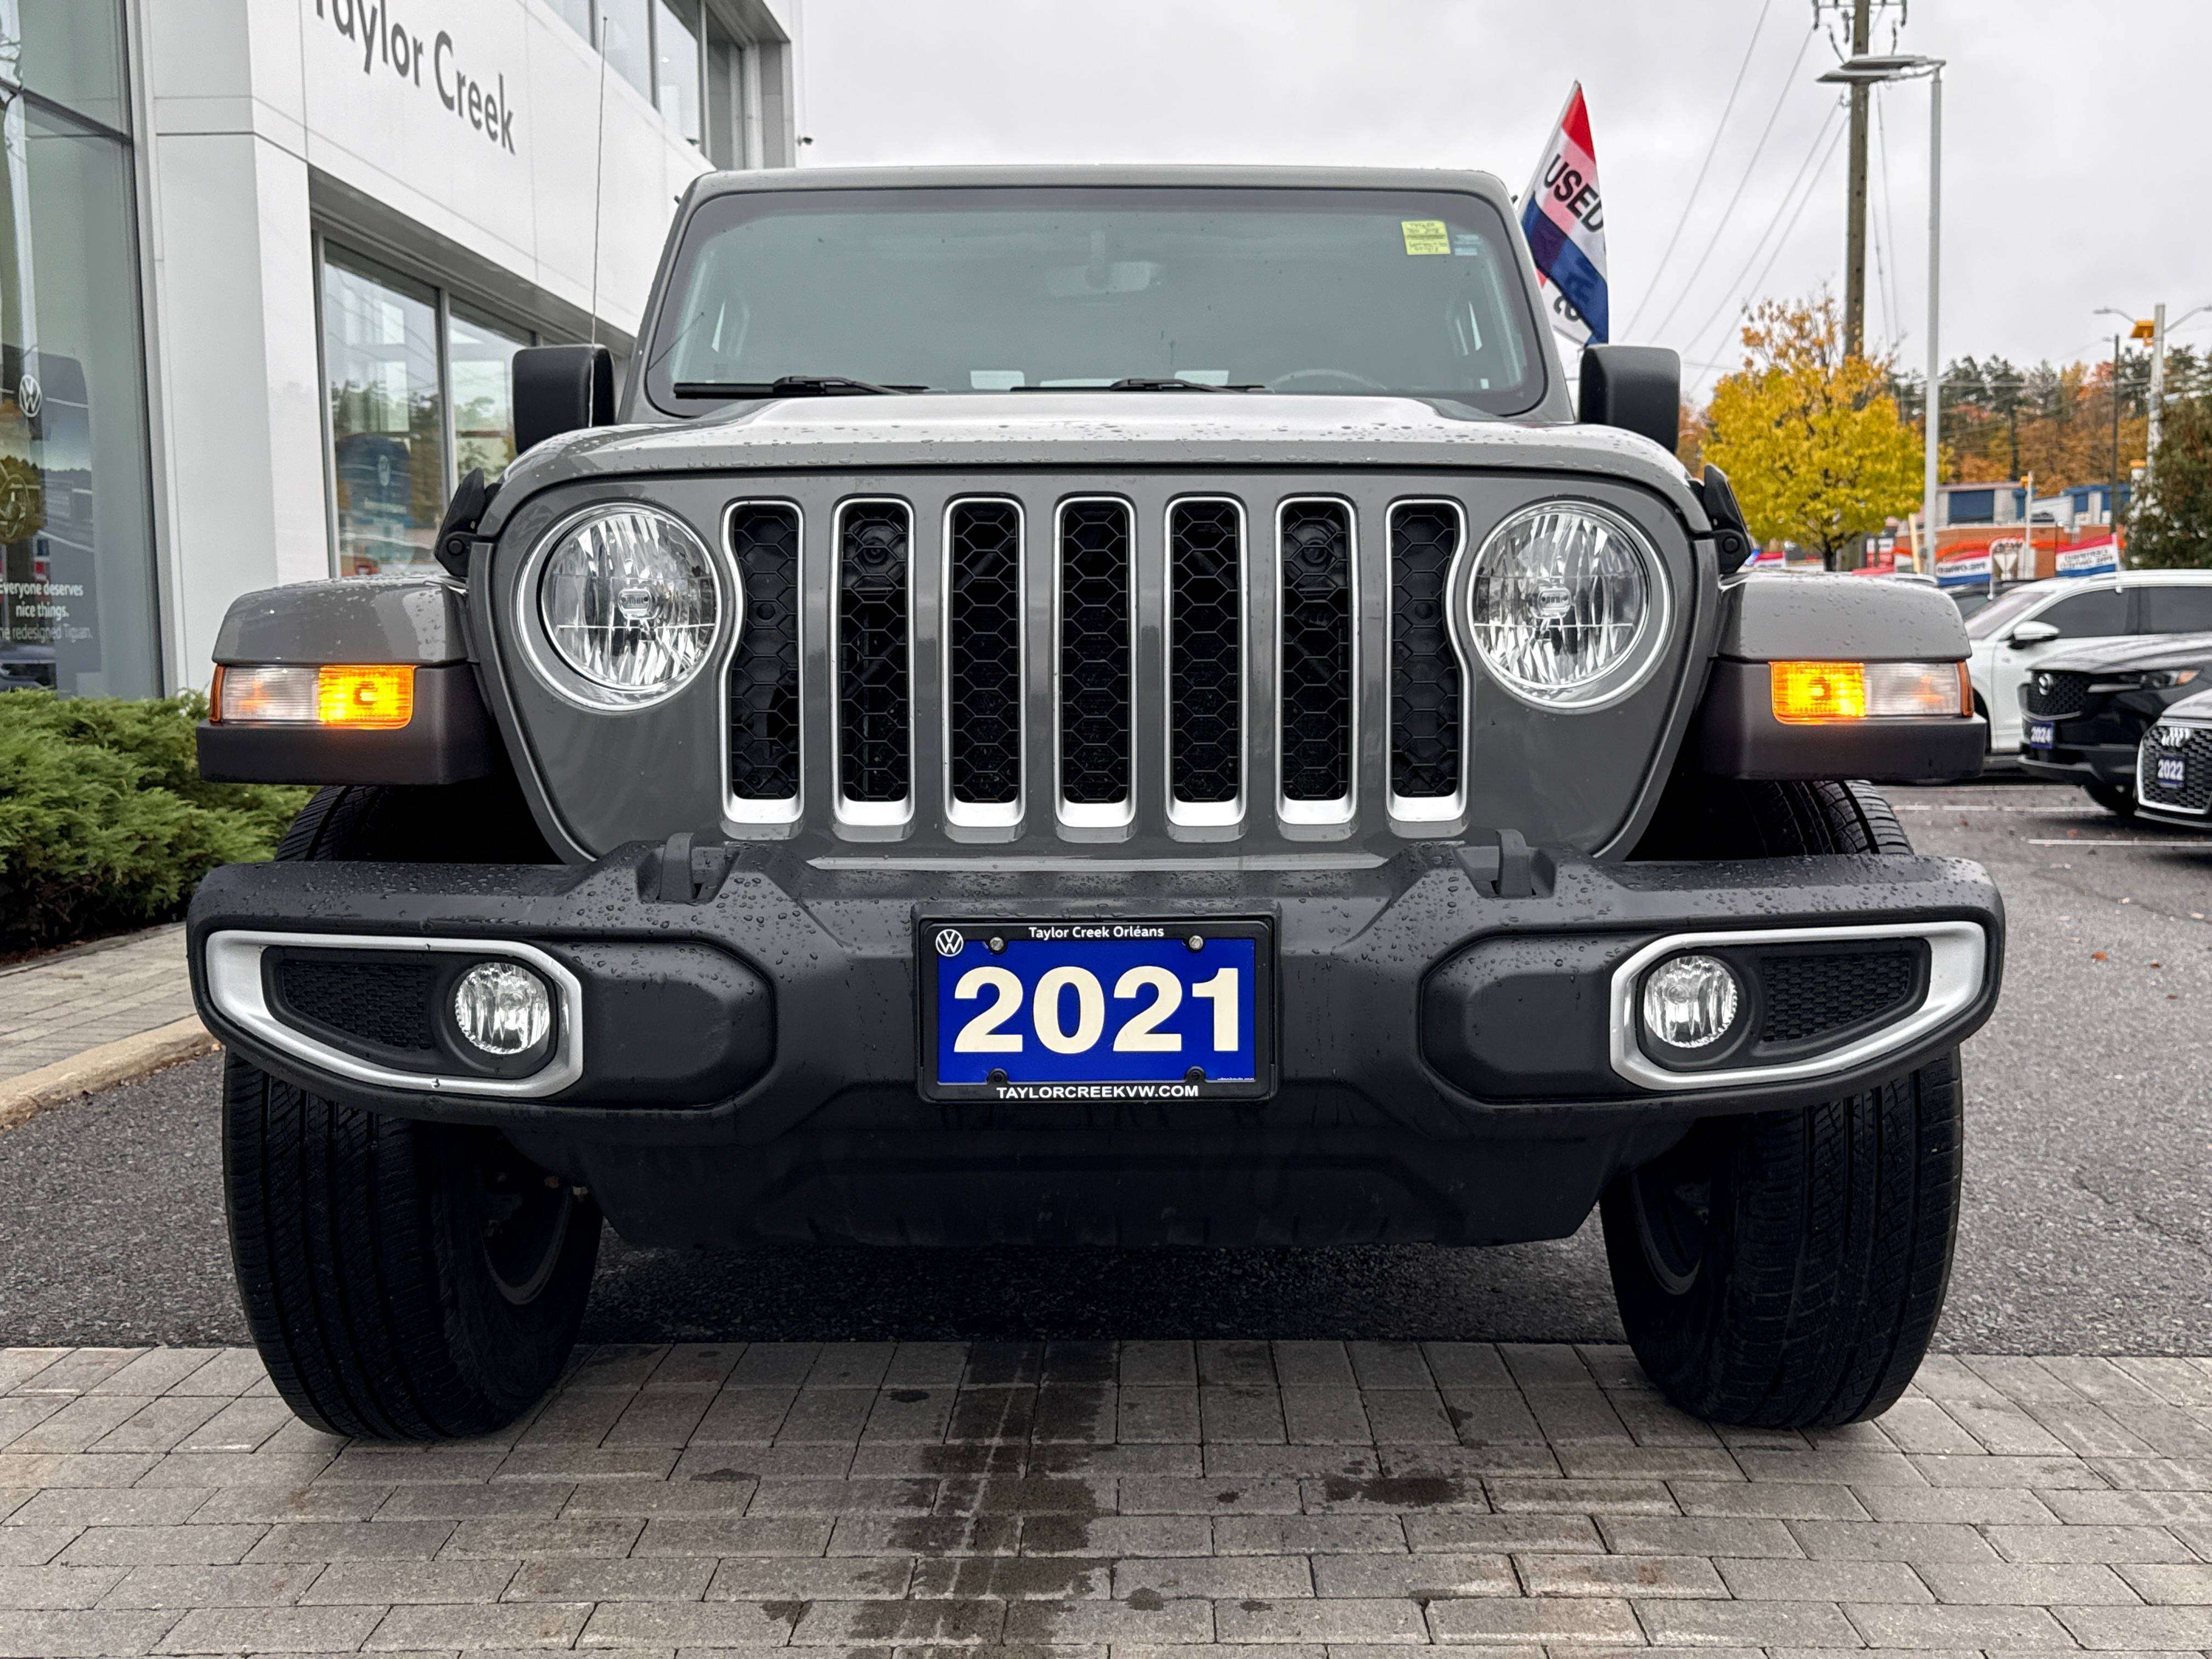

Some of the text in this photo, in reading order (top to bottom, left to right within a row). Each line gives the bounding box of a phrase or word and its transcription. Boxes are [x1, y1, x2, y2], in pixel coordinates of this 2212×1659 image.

[315, 0, 516, 155] aylor Creek
[1544, 153, 1604, 233] USED
[43, 580, 83, 597] deserves
[15, 601, 70, 622] nice things.
[2157, 759, 2184, 780] 2022
[1028, 925, 1164, 941] Taylor Creek Orléans
[953, 966, 1239, 1054] 2021
[996, 1085, 1199, 1099] TAYLORCREEKVW.COM
